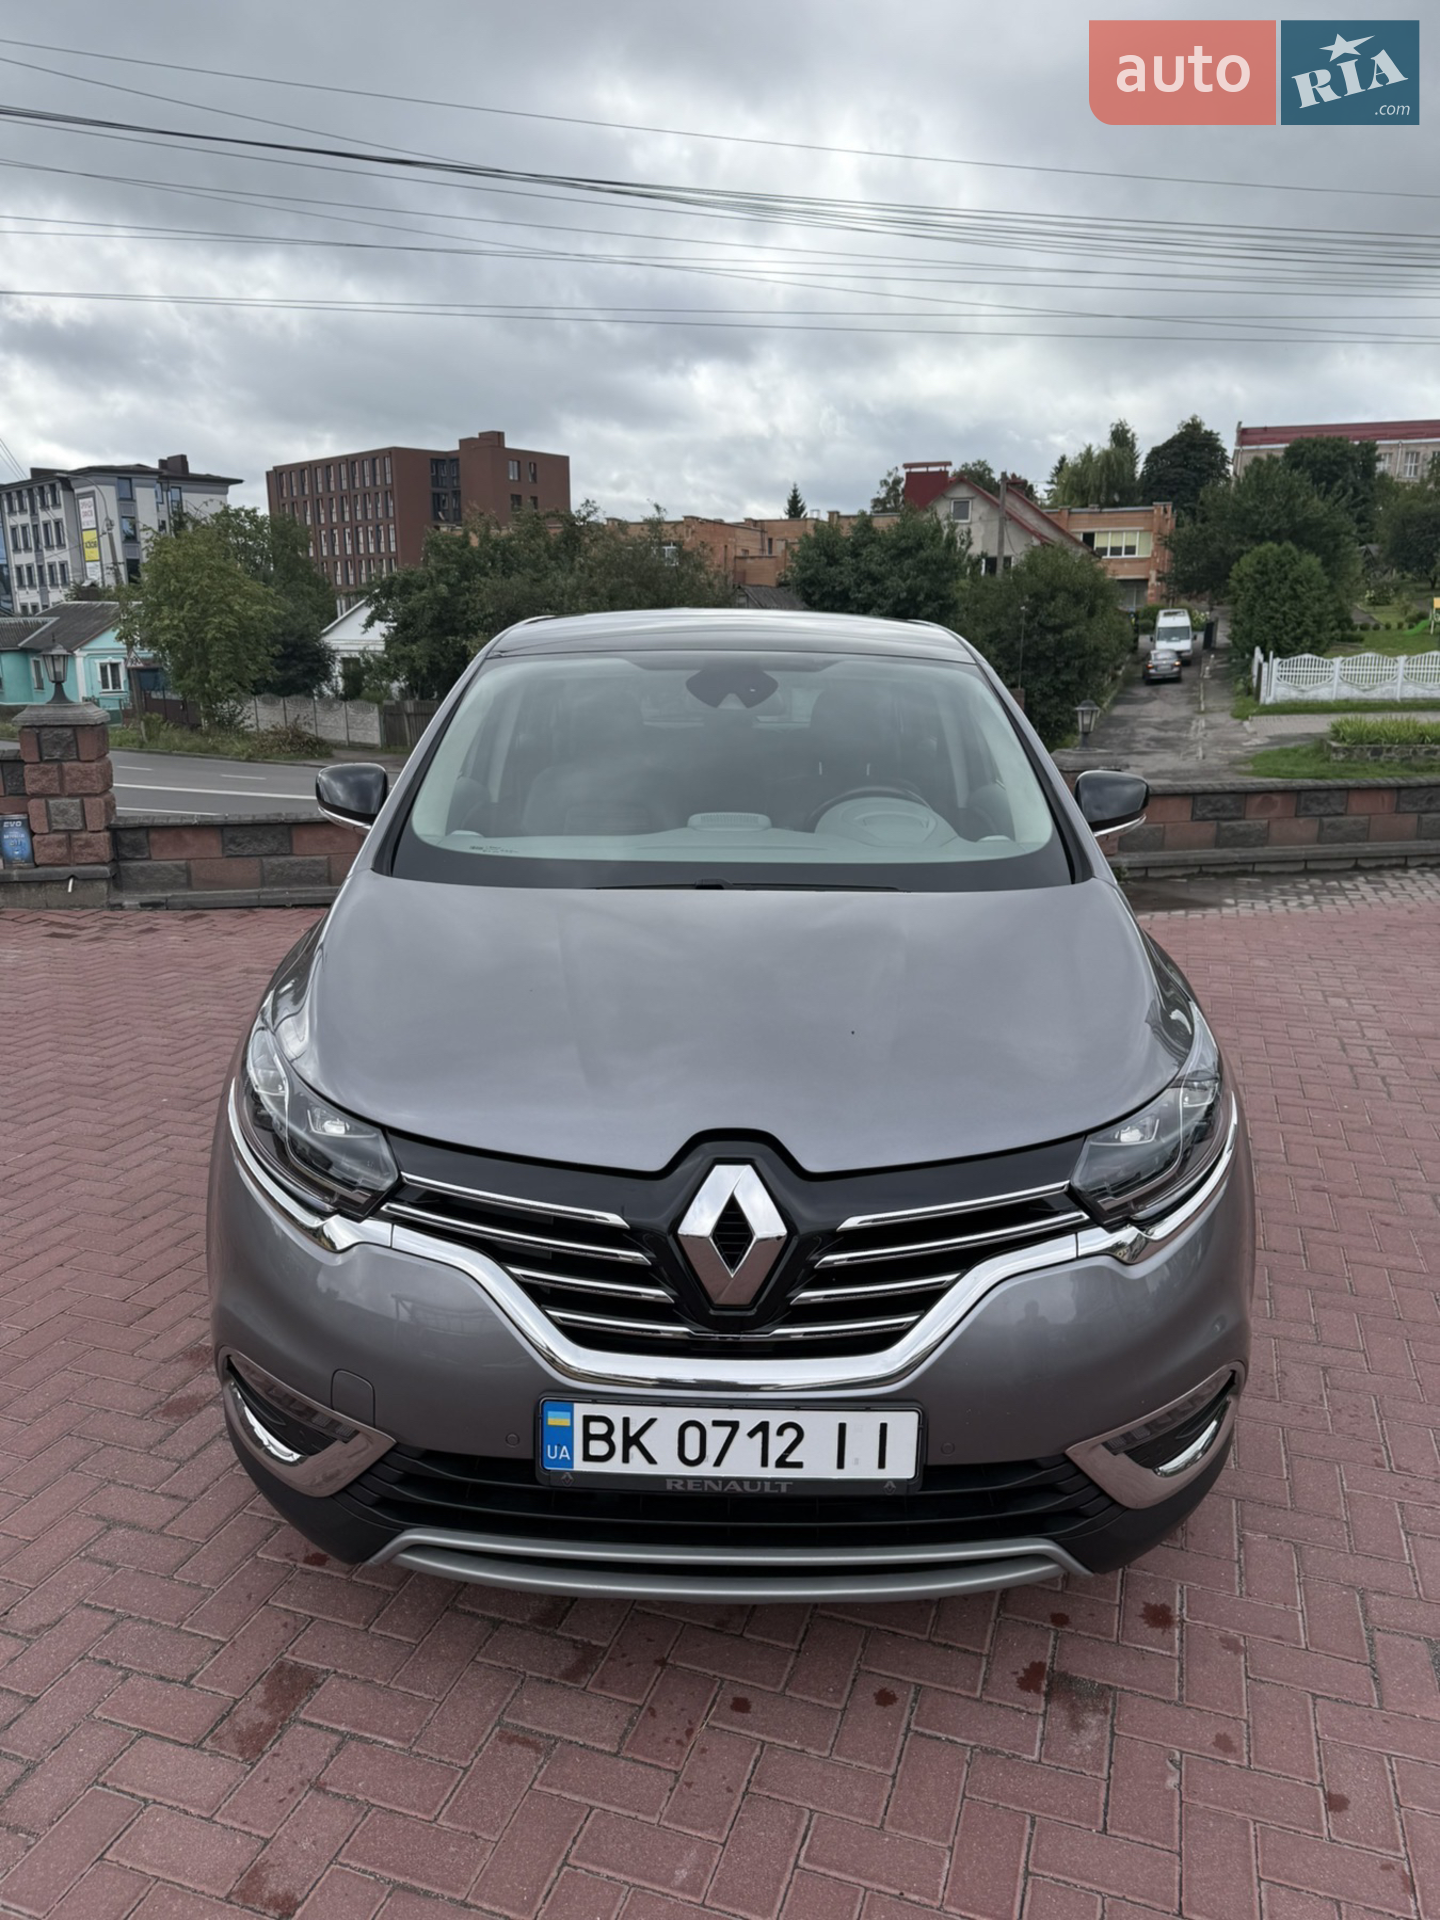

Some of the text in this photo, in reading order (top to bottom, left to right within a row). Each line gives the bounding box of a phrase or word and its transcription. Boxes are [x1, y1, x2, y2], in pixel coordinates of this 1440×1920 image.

[582, 1414, 658, 1465] BK
[677, 1420, 805, 1468] 0712
[547, 1444, 570, 1460] UA
[665, 1478, 793, 1493] RENAULT
